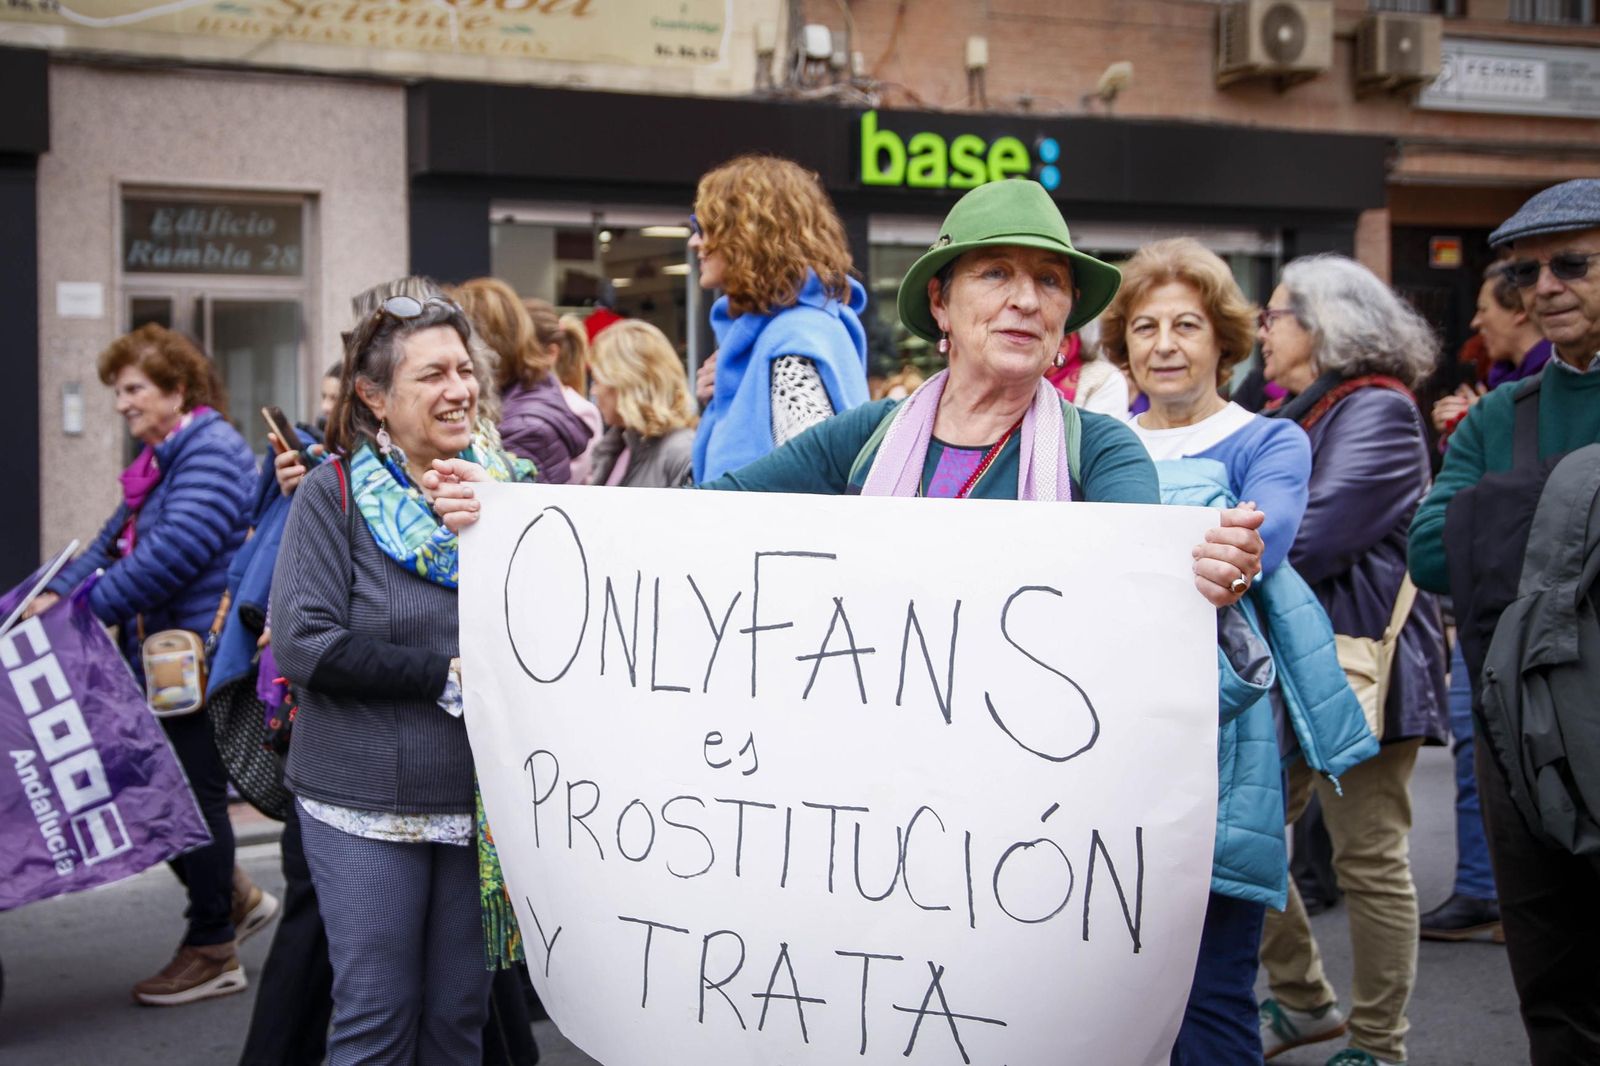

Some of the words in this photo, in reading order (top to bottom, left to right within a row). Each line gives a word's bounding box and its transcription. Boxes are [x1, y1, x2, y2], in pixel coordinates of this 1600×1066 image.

[127, 240, 252, 269] Rambla
[260, 244, 299, 271] 28
[151, 207, 276, 237] Edificio
[703, 730, 759, 776] es
[9, 748, 76, 877] Andalucía
[524, 749, 1144, 954] PROSTITUCIÓN
[526, 896, 562, 978] Y
[618, 915, 1007, 1064] TRATA
